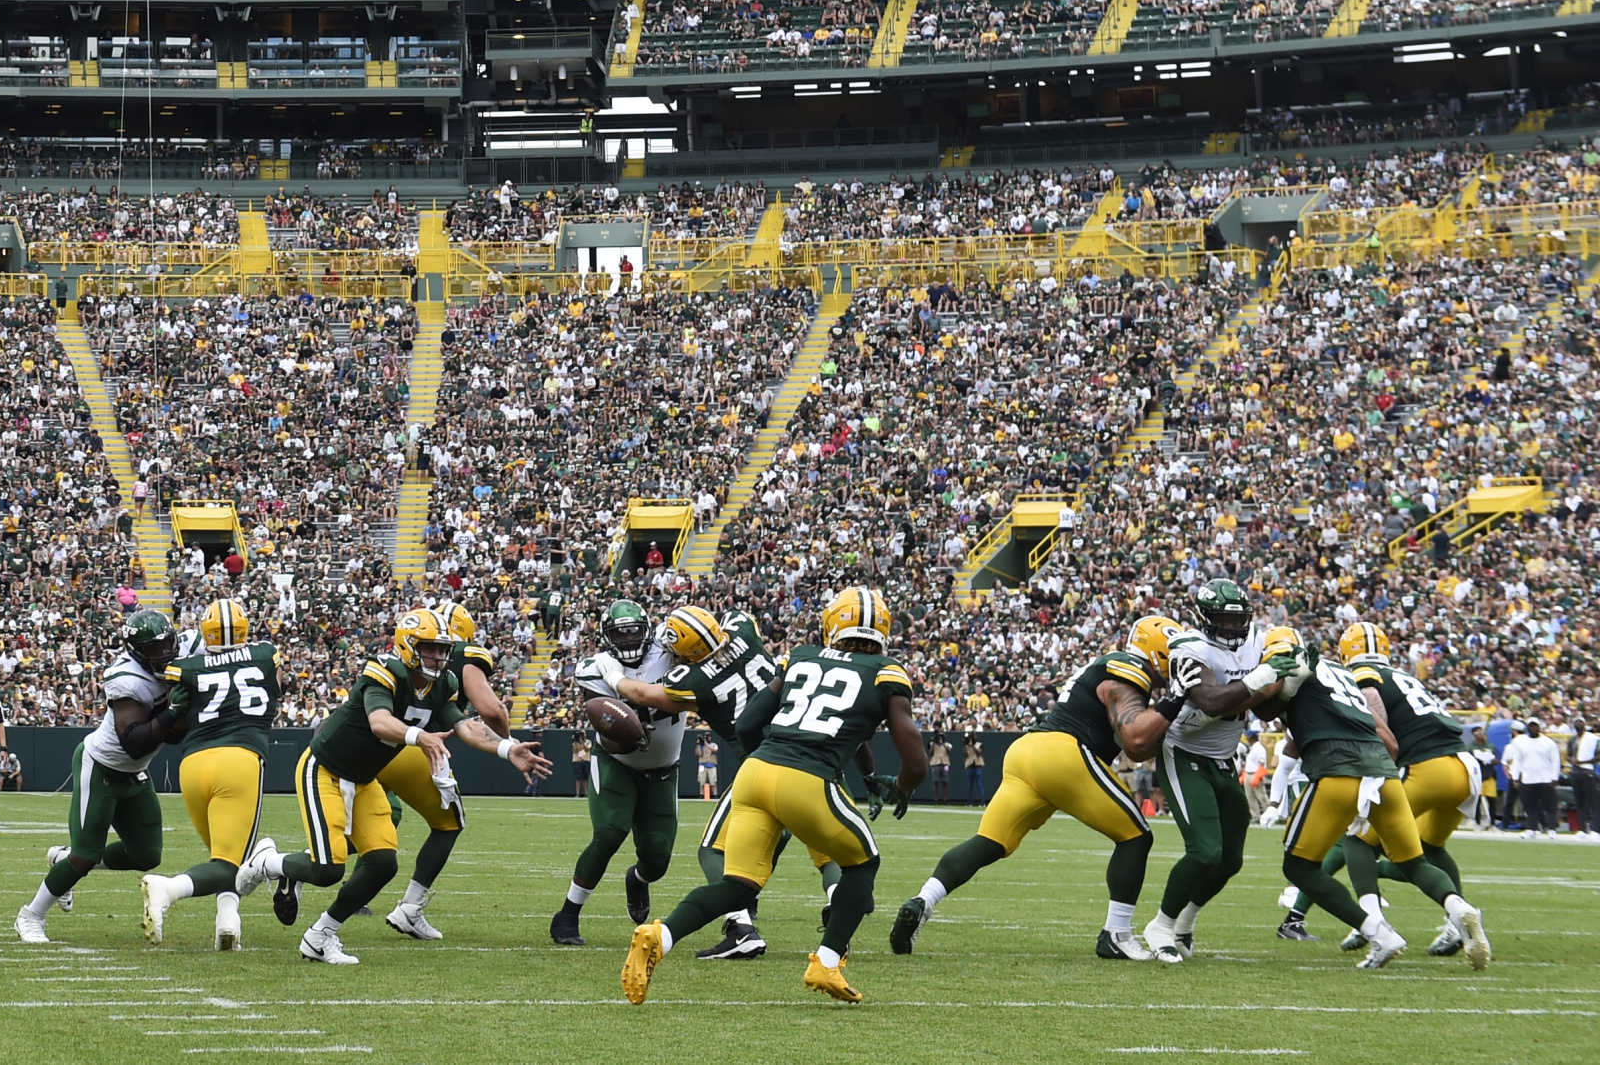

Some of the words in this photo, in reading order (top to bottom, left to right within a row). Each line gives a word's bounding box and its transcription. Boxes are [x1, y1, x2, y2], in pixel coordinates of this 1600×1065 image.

[550, 596, 561, 605] 87
[204, 647, 252, 667] RUNYAN
[818, 648, 853, 661] HILL
[196, 667, 270, 723] 76
[712, 653, 776, 725] 70
[771, 661, 862, 738] 32
[404, 705, 432, 729] 7
